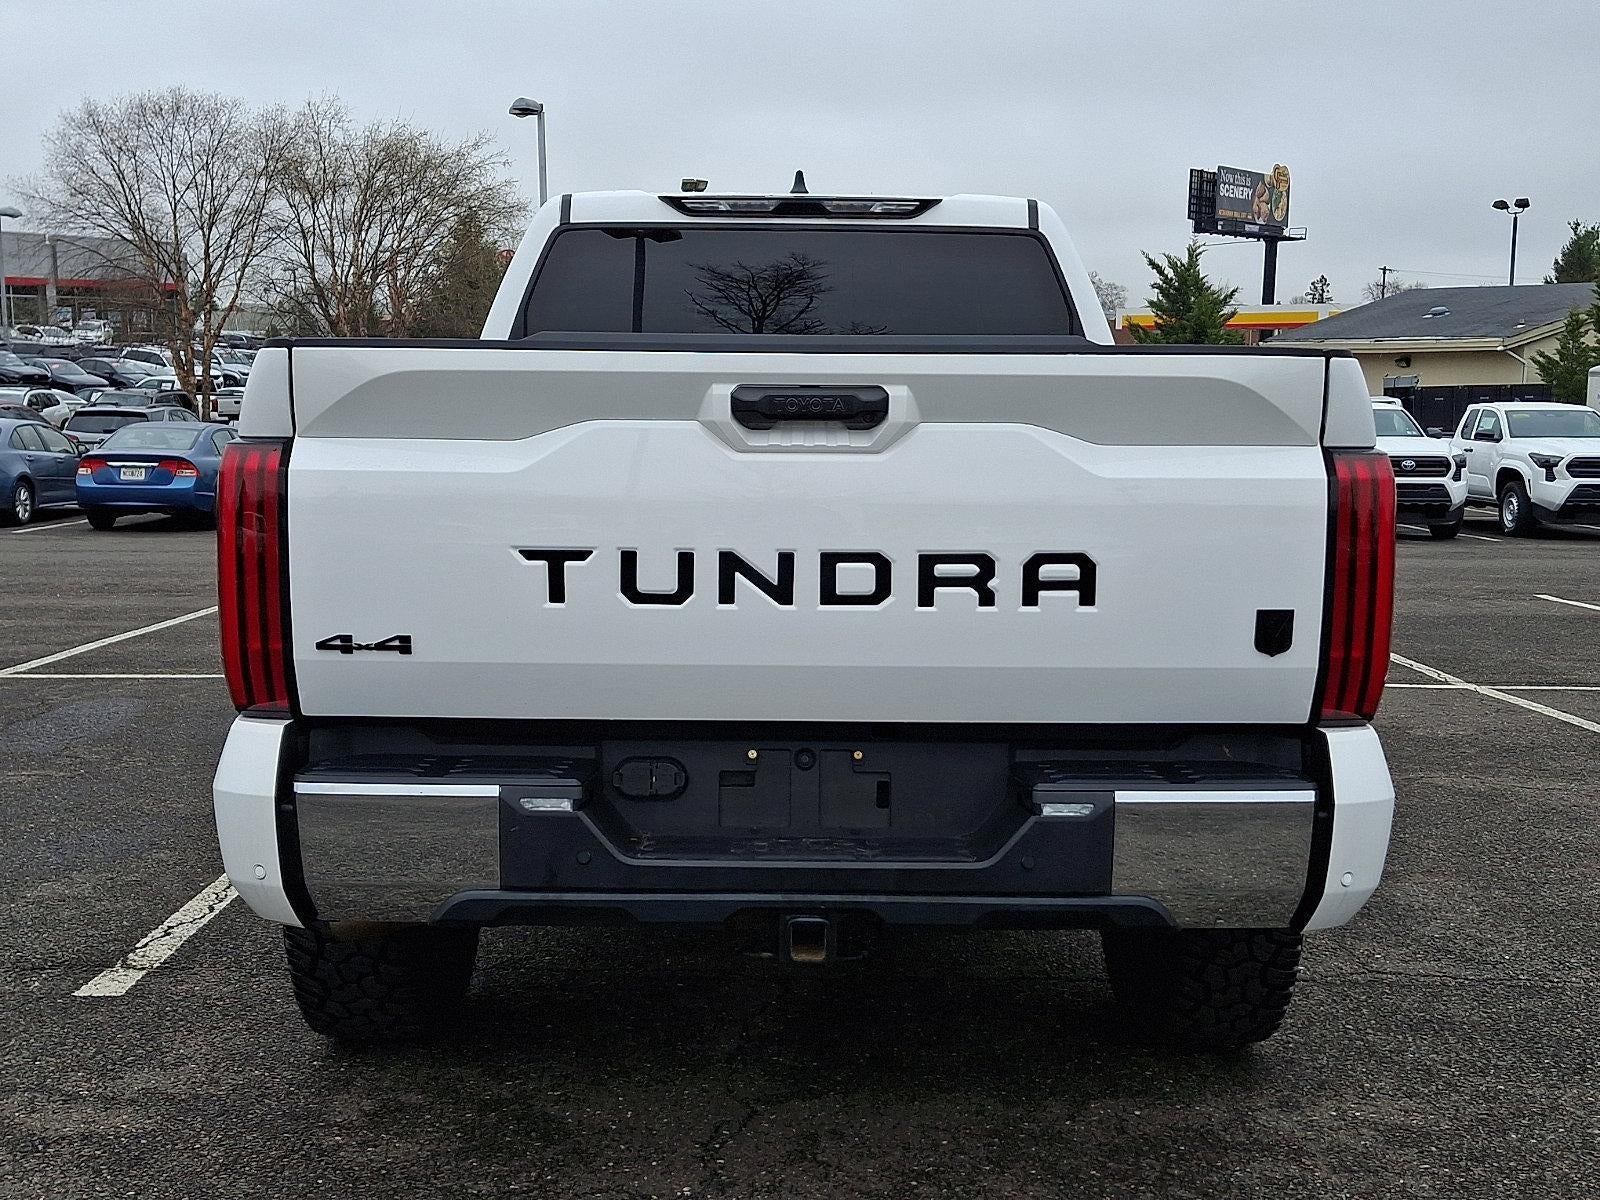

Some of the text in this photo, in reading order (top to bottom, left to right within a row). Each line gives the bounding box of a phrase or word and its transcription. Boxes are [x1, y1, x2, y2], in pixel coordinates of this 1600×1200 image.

[1220, 169, 1251, 186] Now this is
[1219, 183, 1253, 200] SCENERY
[774, 397, 846, 412] TOYOTA
[514, 547, 1098, 610] TUNDRA
